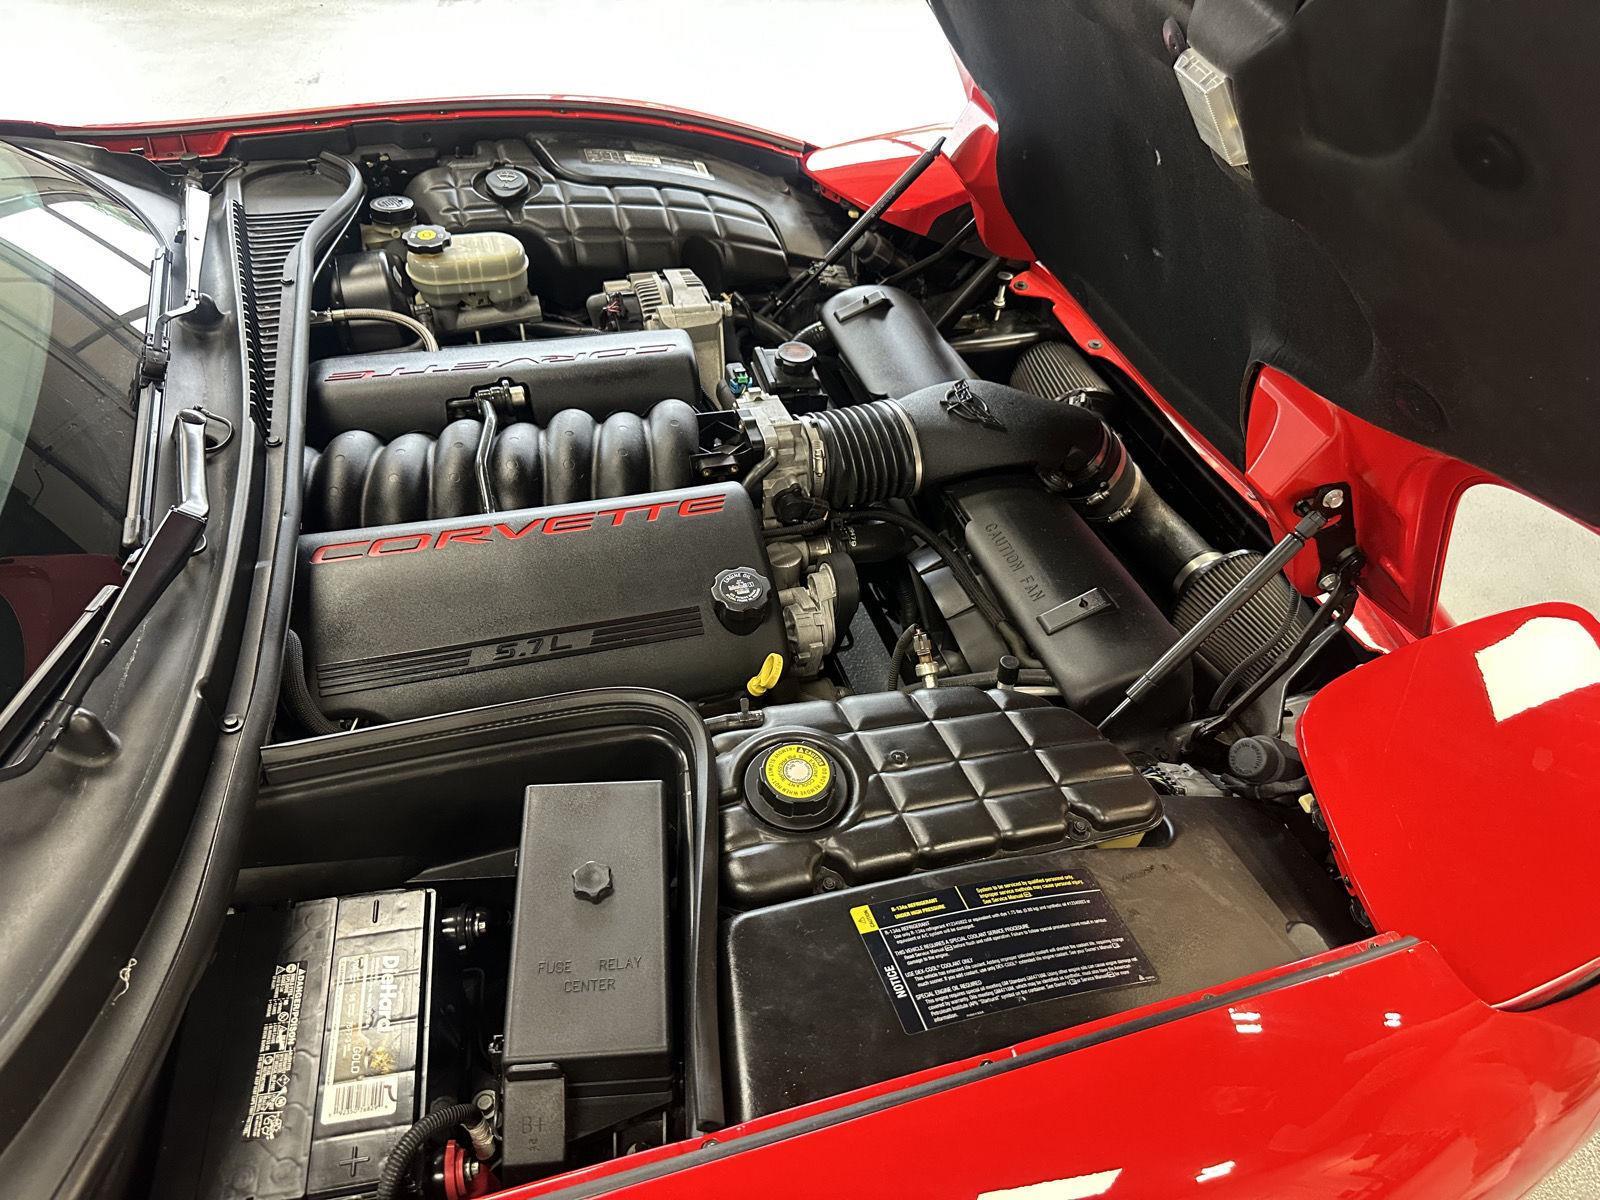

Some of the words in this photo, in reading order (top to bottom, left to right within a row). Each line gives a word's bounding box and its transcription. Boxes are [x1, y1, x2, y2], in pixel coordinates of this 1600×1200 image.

[324, 343, 676, 382] CORVETTE
[310, 494, 727, 564] CORVETTE
[985, 523, 1025, 572] CAUTION
[1019, 575, 1046, 602] FAN
[493, 635, 573, 662] 5.7L
[907, 898, 938, 908] REFRIGERANT
[905, 945, 924, 953] VEHICLE
[949, 936, 967, 944] SPECIAL
[538, 960, 572, 975] FUSE
[600, 956, 641, 972] RELAY
[376, 955, 400, 1033] DieHard
[564, 978, 616, 992] CENTER
[884, 965, 907, 998] NOTICE
[915, 992, 935, 1000] SPECIAL
[934, 987, 952, 995] ENGINE
[959, 980, 982, 989] REQUIRED
[287, 975, 305, 1046] DANGER/POISON
[351, 1046, 361, 1073] GOLD
